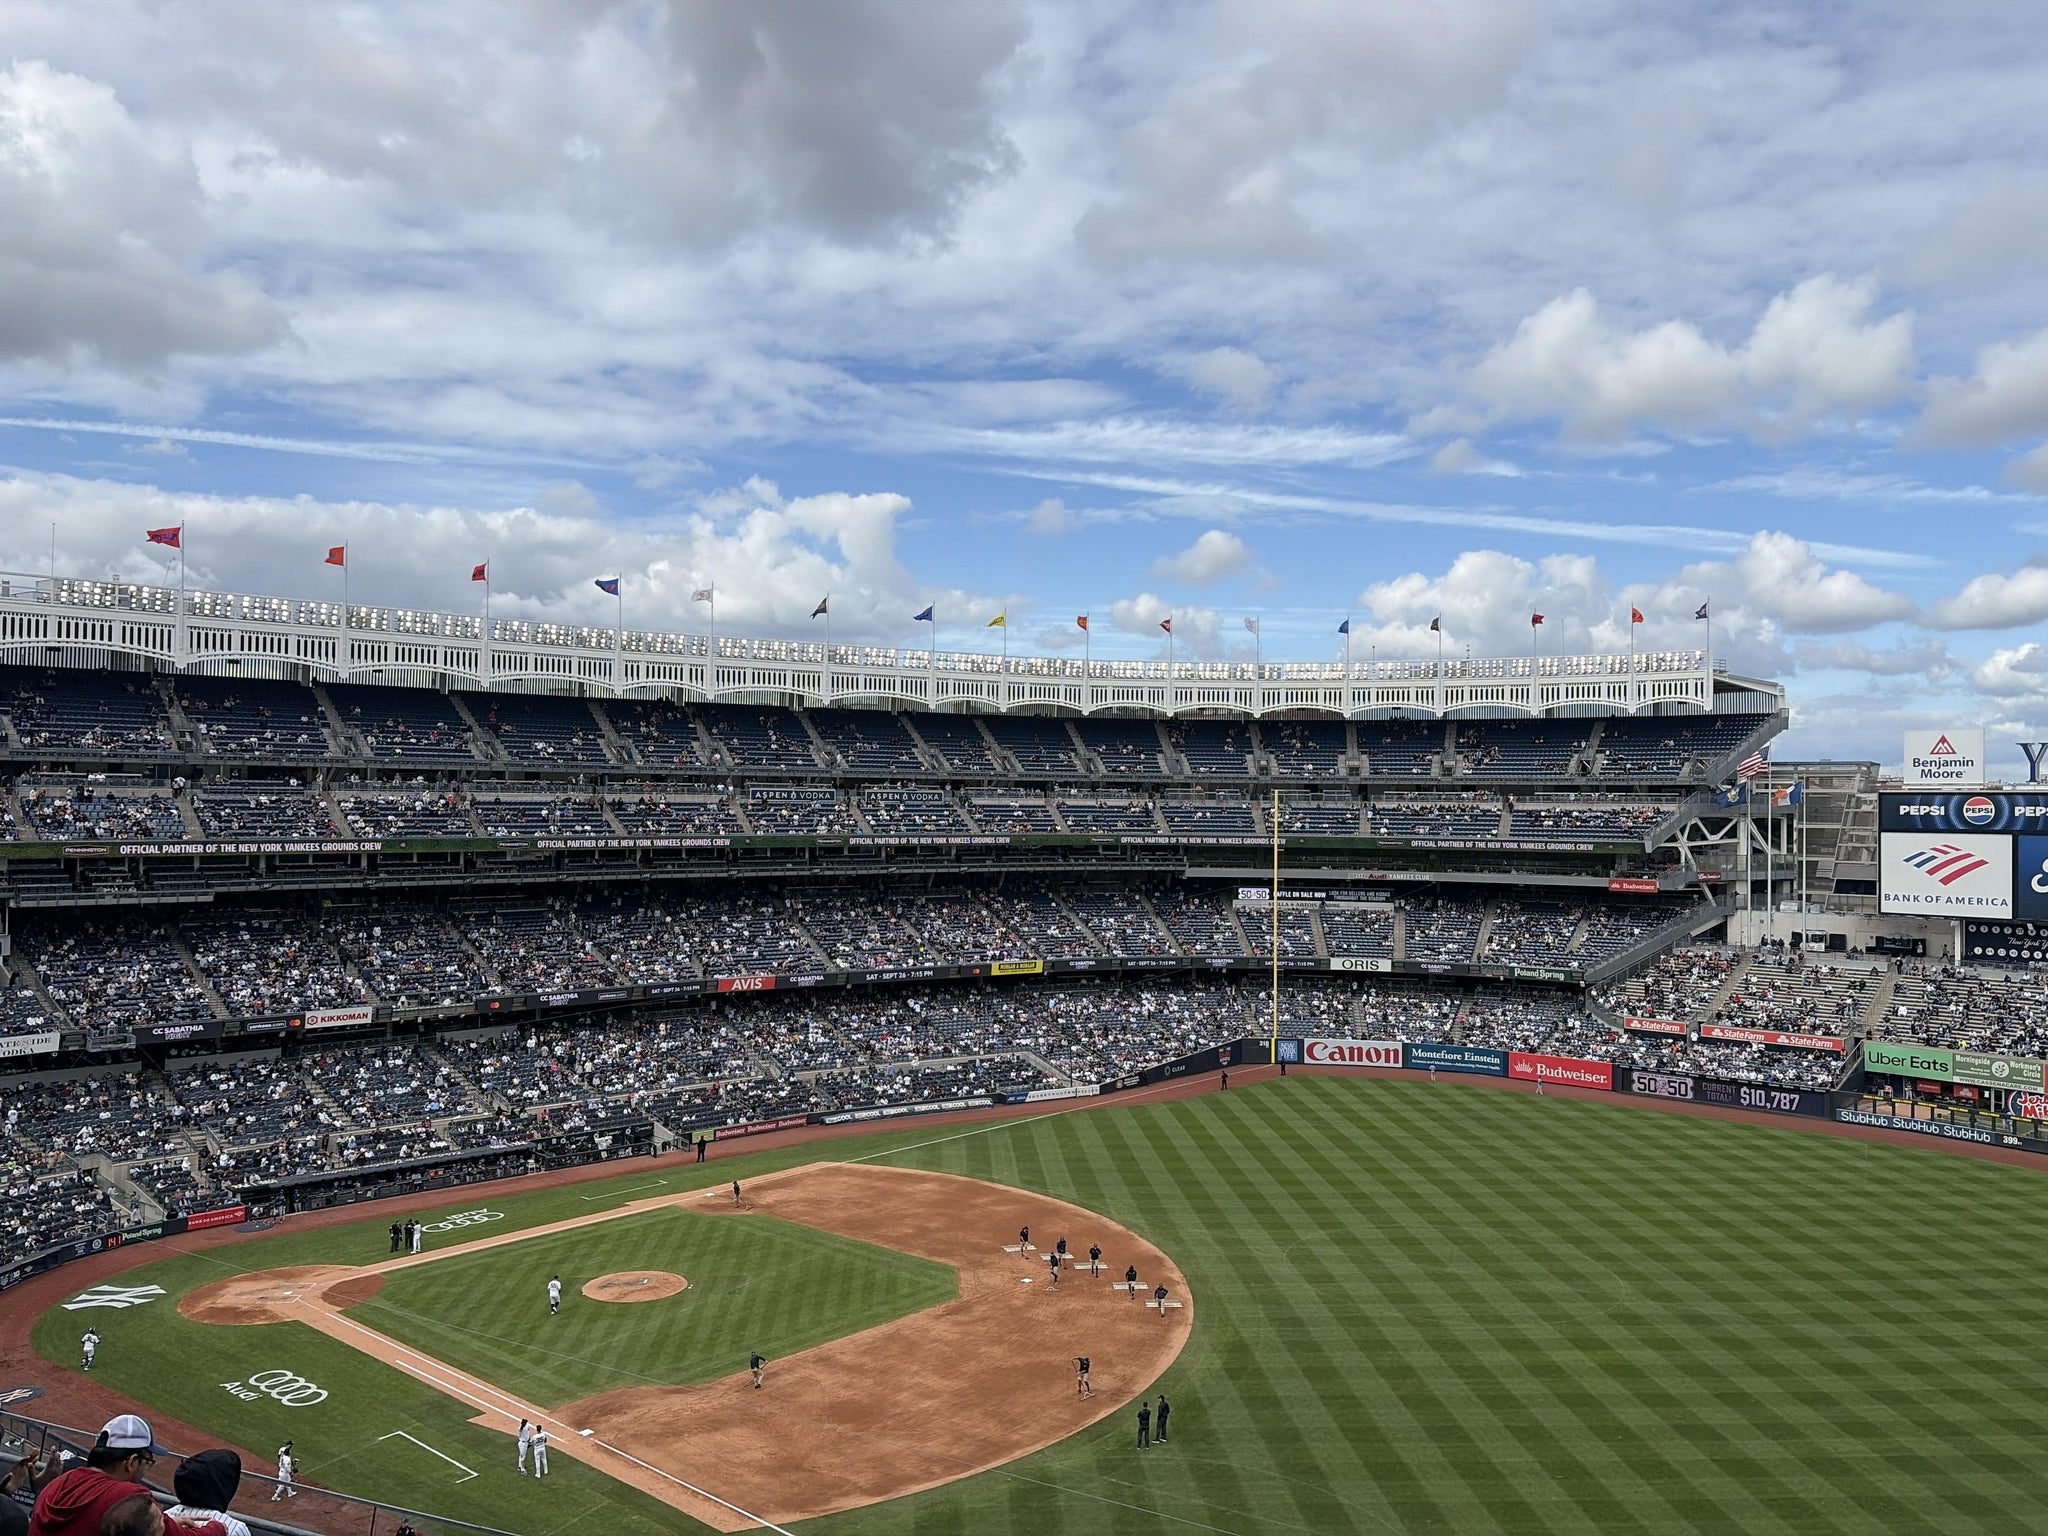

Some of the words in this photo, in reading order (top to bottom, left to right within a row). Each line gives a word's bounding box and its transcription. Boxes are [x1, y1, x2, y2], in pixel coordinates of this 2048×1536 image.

[1912, 756, 1974, 770] Benjamin
[1920, 768, 1964, 779] Moore
[755, 791, 788, 799] ASPEN
[799, 791, 831, 799] VODKA
[869, 792, 900, 800] ASPEN
[1899, 805, 1945, 816] PEPSI
[537, 840, 566, 848] OFFICIAL
[567, 840, 597, 848] PARTNER
[598, 840, 606, 848] OF
[607, 839, 620, 848] THE
[620, 839, 635, 847] NEW
[635, 839, 652, 847] YORK
[652, 839, 681, 847] YANKEES
[681, 838, 712, 847] GROUNDS
[712, 838, 731, 846] CREW
[849, 837, 874, 845] OFFICIAL
[874, 837, 900, 845] PARTNER
[971, 836, 996, 844] GROUNDS
[996, 836, 1010, 844] CREW
[1120, 836, 1144, 844] OFFICIAL
[1218, 837, 1243, 845] YANKEES
[1243, 837, 1270, 845] GROUNDS
[1411, 840, 1437, 848] OFFICIAL
[1437, 840, 1464, 849] PARTNER
[1465, 841, 1474, 849] OF
[1474, 841, 1486, 849] THE
[1487, 841, 1501, 849] NEW
[1502, 841, 1519, 850] YORK
[1519, 842, 1546, 850] YANKEES
[1546, 842, 1576, 851] GROUNDS
[1576, 843, 1594, 851] CREW
[120, 844, 160, 854] OFFICIAL
[162, 844, 204, 853] PARTNER
[205, 844, 218, 853] OF
[220, 843, 237, 853] THE
[238, 843, 258, 852] NEW
[259, 843, 283, 852] YORK
[284, 842, 320, 852] YANKEES
[321, 842, 359, 851] GROUNDS
[360, 842, 382, 851] CREW
[1622, 882, 1656, 891] Budweiser
[1241, 890, 1252, 899] 50
[1255, 890, 1267, 899] 50
[1274, 890, 1291, 898] AFFLE
[1300, 891, 1313, 899] SALE
[1884, 893, 1921, 903] BANK
[1924, 895, 1942, 904] OF
[1945, 896, 2009, 907] AMERICA
[2007, 936, 2024, 946] New
[2023, 938, 2041, 949] York
[1341, 959, 1380, 971] ORIS
[797, 974, 825, 982] SABATHIA
[882, 972, 898, 980] SEPT
[1514, 967, 1539, 977] Poland
[1539, 969, 1565, 981] Spring
[731, 979, 763, 991] AVIS
[549, 992, 579, 1001] SABATHIA
[320, 1012, 369, 1023] KIKKOMAN
[152, 1027, 164, 1035] CC
[164, 1024, 204, 1034] SABATHIA
[164, 1031, 192, 1041] NIGHT
[1305, 1041, 1400, 1064] Canon
[1411, 1047, 1462, 1060] Montefiore
[1464, 1052, 1500, 1064] Einstein
[1868, 1050, 1907, 1067] Uber
[1910, 1056, 1949, 1073] Eats
[1955, 1054, 1991, 1066] Morningside
[1171, 1065, 1186, 1073] CLEAR
[2009, 1060, 2042, 1072] Workmen's
[2023, 1069, 2041, 1079] Circle
[1637, 1075, 1658, 1093] 50
[1667, 1079, 1688, 1097] 50
[1702, 1081, 1737, 1095] CURRENT
[1706, 1091, 1732, 1101] TOTAL:
[1740, 1086, 1800, 1111] $10,787
[715, 1127, 746, 1138] Budweiser
[747, 1122, 777, 1133] Budweiser
[778, 1116, 807, 1128] Budweiser
[1840, 1111, 1889, 1127] StubHub
[1892, 1117, 1940, 1134] StubHub
[1943, 1125, 1991, 1143] StubHub
[2002, 1135, 2018, 1145] 399
[188, 1218, 202, 1226] BANK
[211, 1213, 234, 1223] AMERICA
[122, 1230, 142, 1242] Poland
[142, 1227, 163, 1238] Spring
[219, 1381, 264, 1402] Audi
